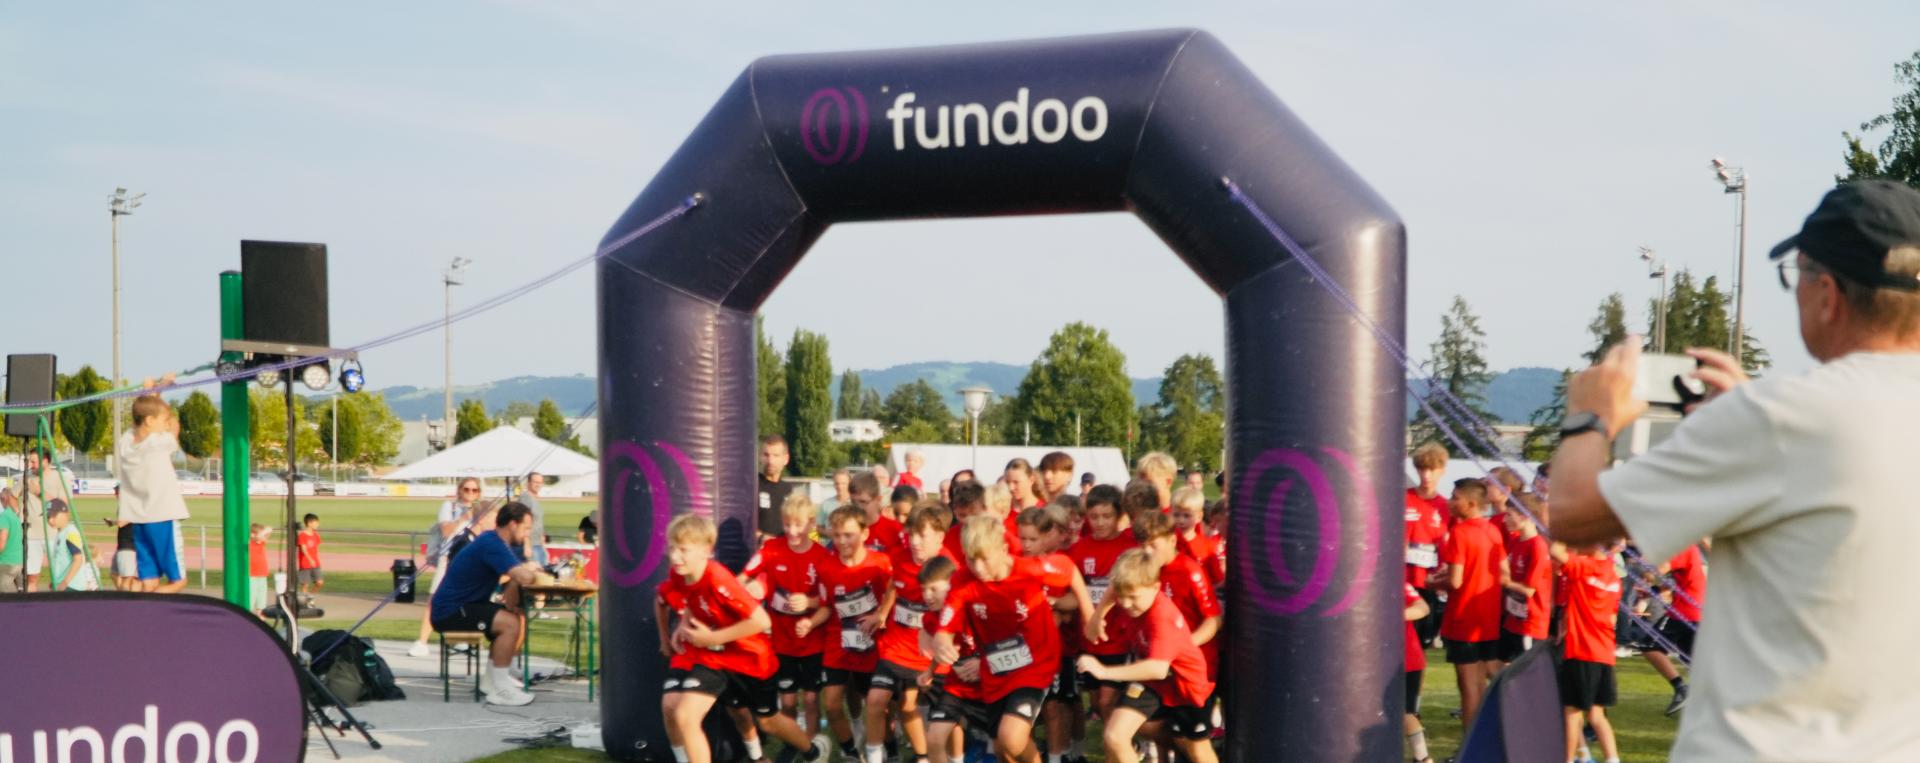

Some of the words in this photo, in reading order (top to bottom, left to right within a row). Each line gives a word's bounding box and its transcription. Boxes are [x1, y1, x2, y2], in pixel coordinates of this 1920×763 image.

[886, 87, 1109, 150] fundoo
[997, 653, 1019, 667] 151
[0, 704, 259, 763] undoo
